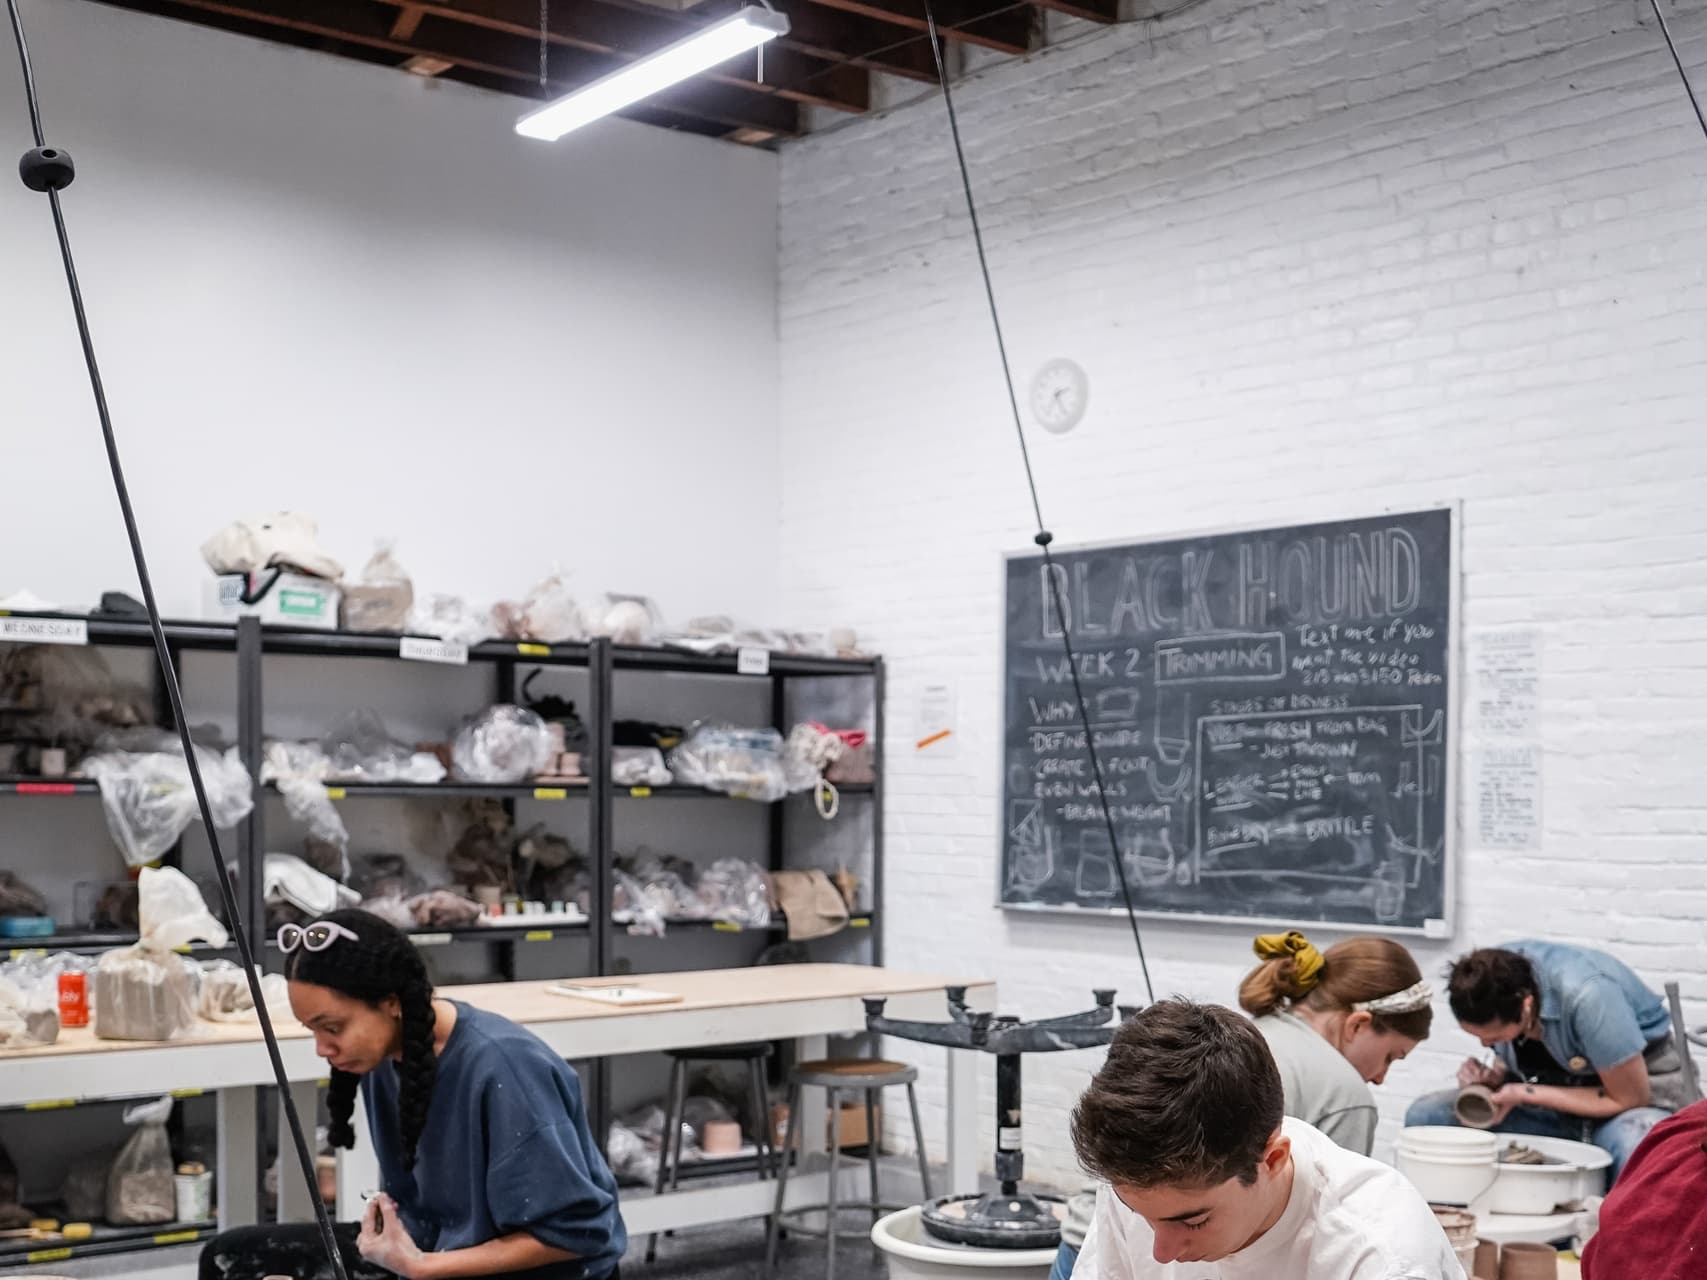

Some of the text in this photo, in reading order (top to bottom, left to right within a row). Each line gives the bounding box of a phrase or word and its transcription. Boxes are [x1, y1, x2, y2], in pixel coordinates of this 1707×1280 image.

[1041, 527, 1421, 639] BLACK HOUND
[1296, 618, 1435, 648] Text me if you
[1035, 648, 1144, 683] WEEK 2
[1158, 643, 1273, 676] TRIMMING
[1264, 719, 1313, 741] FRESH
[1304, 815, 1375, 843] BRITTLE
